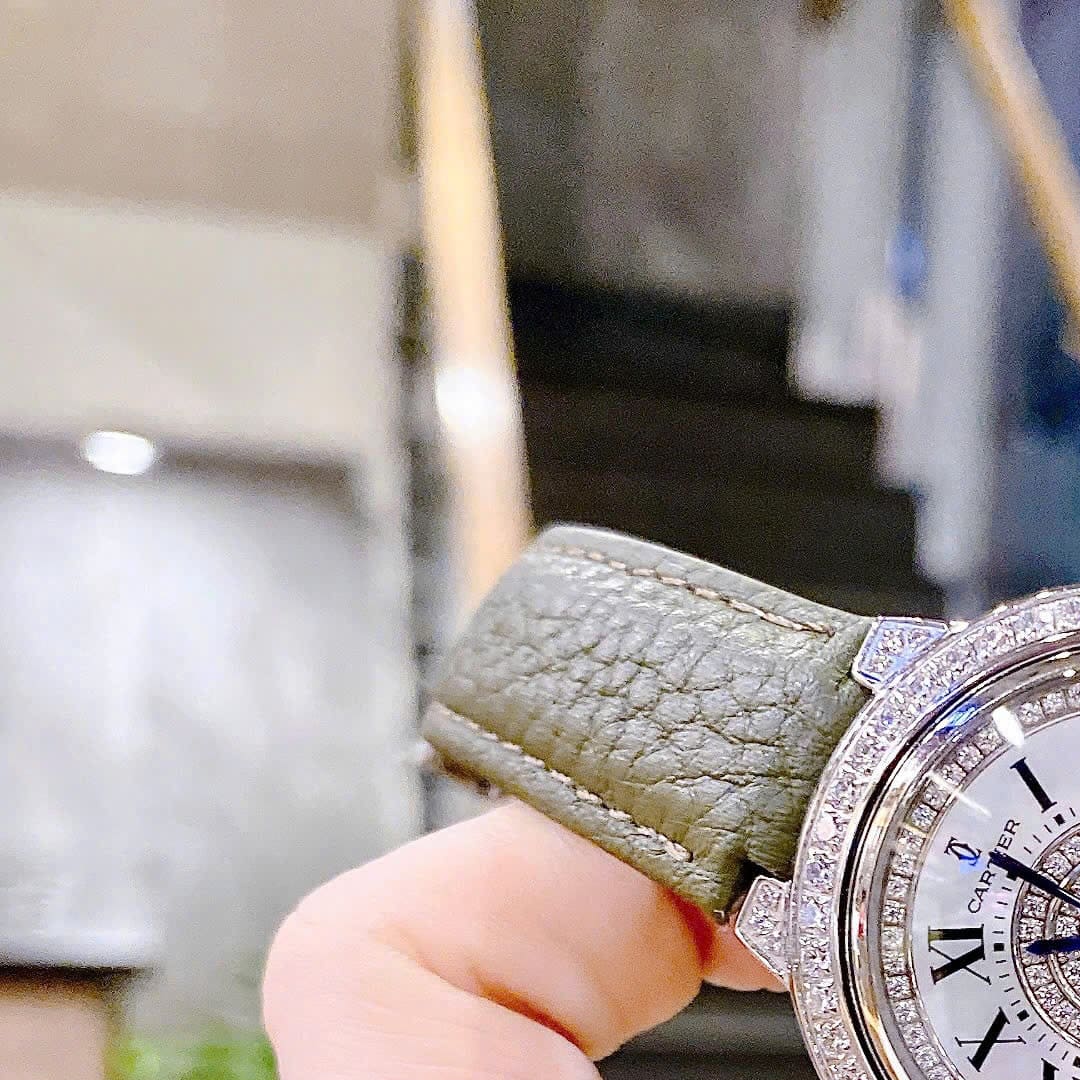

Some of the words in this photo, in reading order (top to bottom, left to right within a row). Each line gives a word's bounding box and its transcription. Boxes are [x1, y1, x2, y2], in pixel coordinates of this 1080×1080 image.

[1009, 757, 1057, 813] I
[968, 819, 1021, 913] CARER
[928, 924, 992, 985] XI
[955, 1006, 1026, 1072] X
